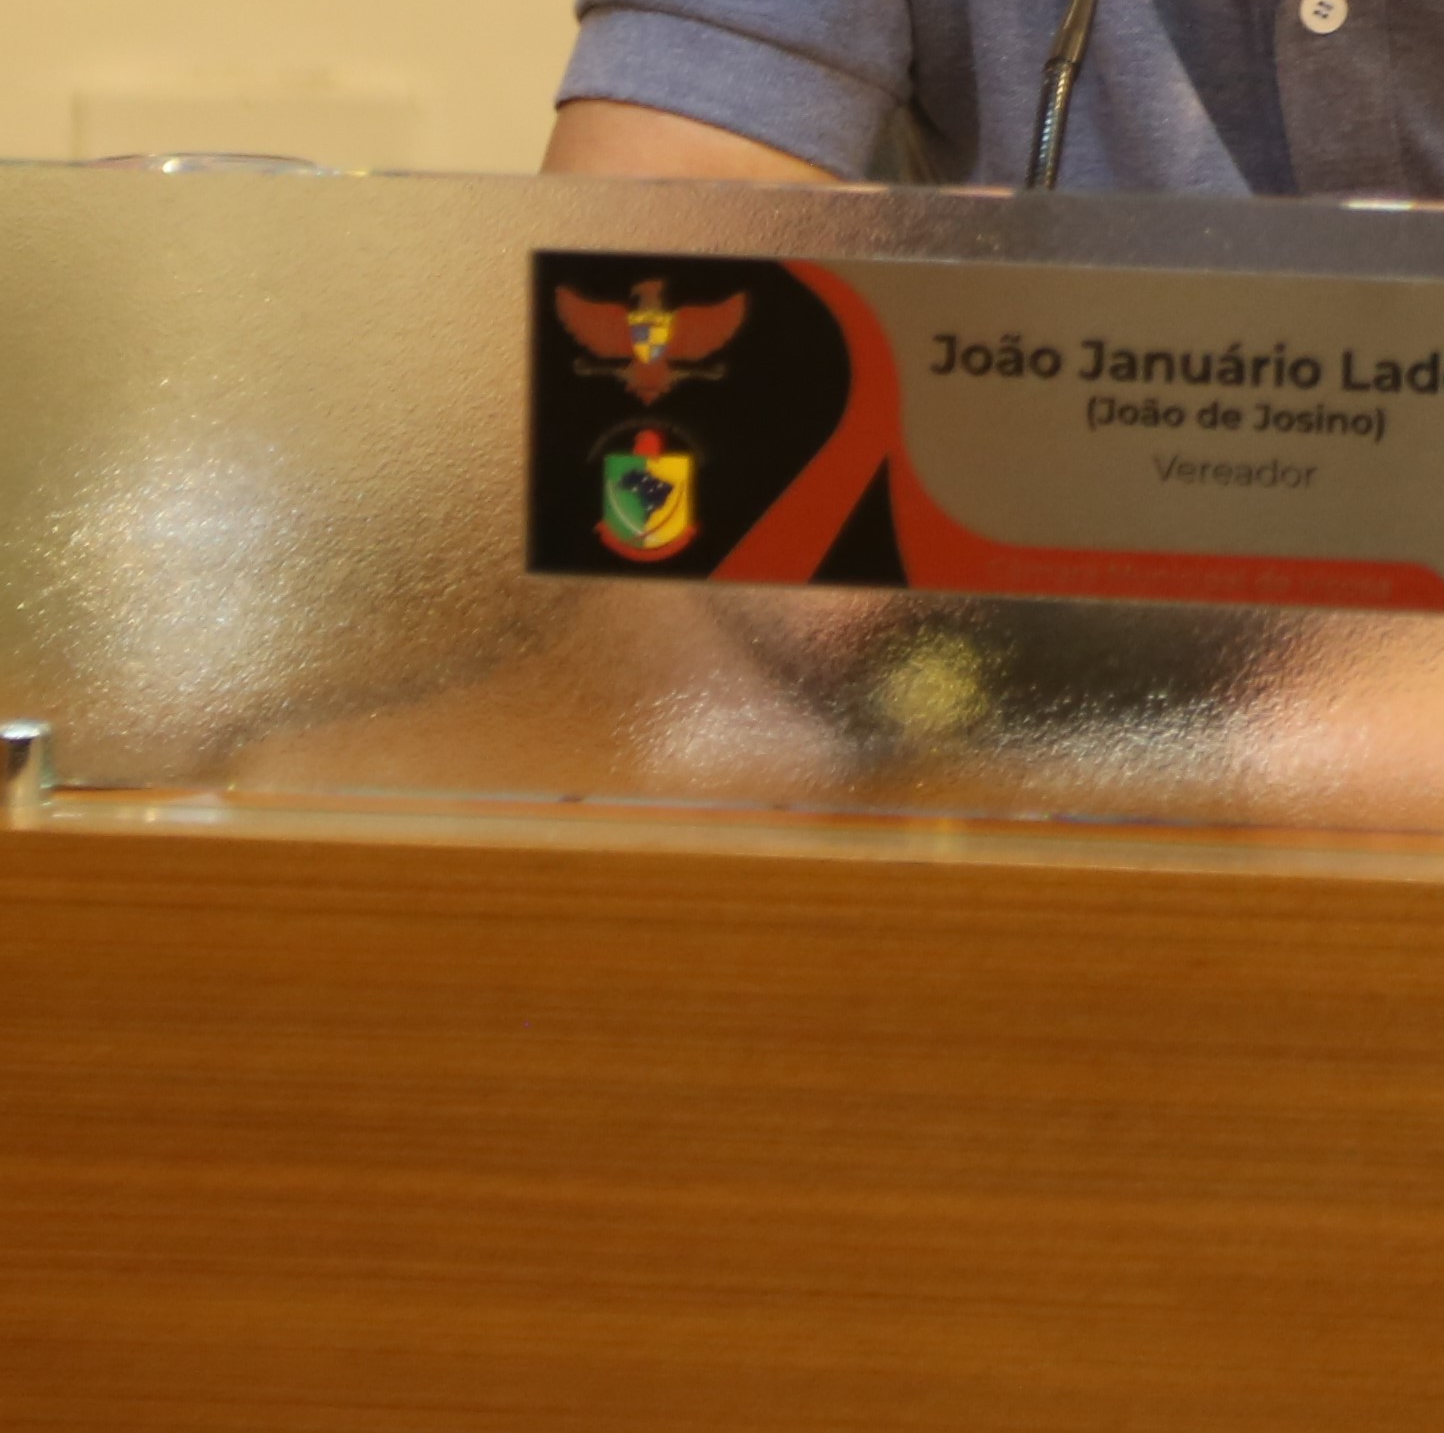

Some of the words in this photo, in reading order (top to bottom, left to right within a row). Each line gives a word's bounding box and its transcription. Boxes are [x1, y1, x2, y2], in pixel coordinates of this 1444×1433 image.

[930, 332, 1063, 379] João
[1078, 339, 1322, 391] Januário
[1086, 395, 1185, 431] (João
[1196, 401, 1243, 430] de
[1253, 403, 1387, 445] Josino)
[1152, 454, 1319, 490] Vereador
